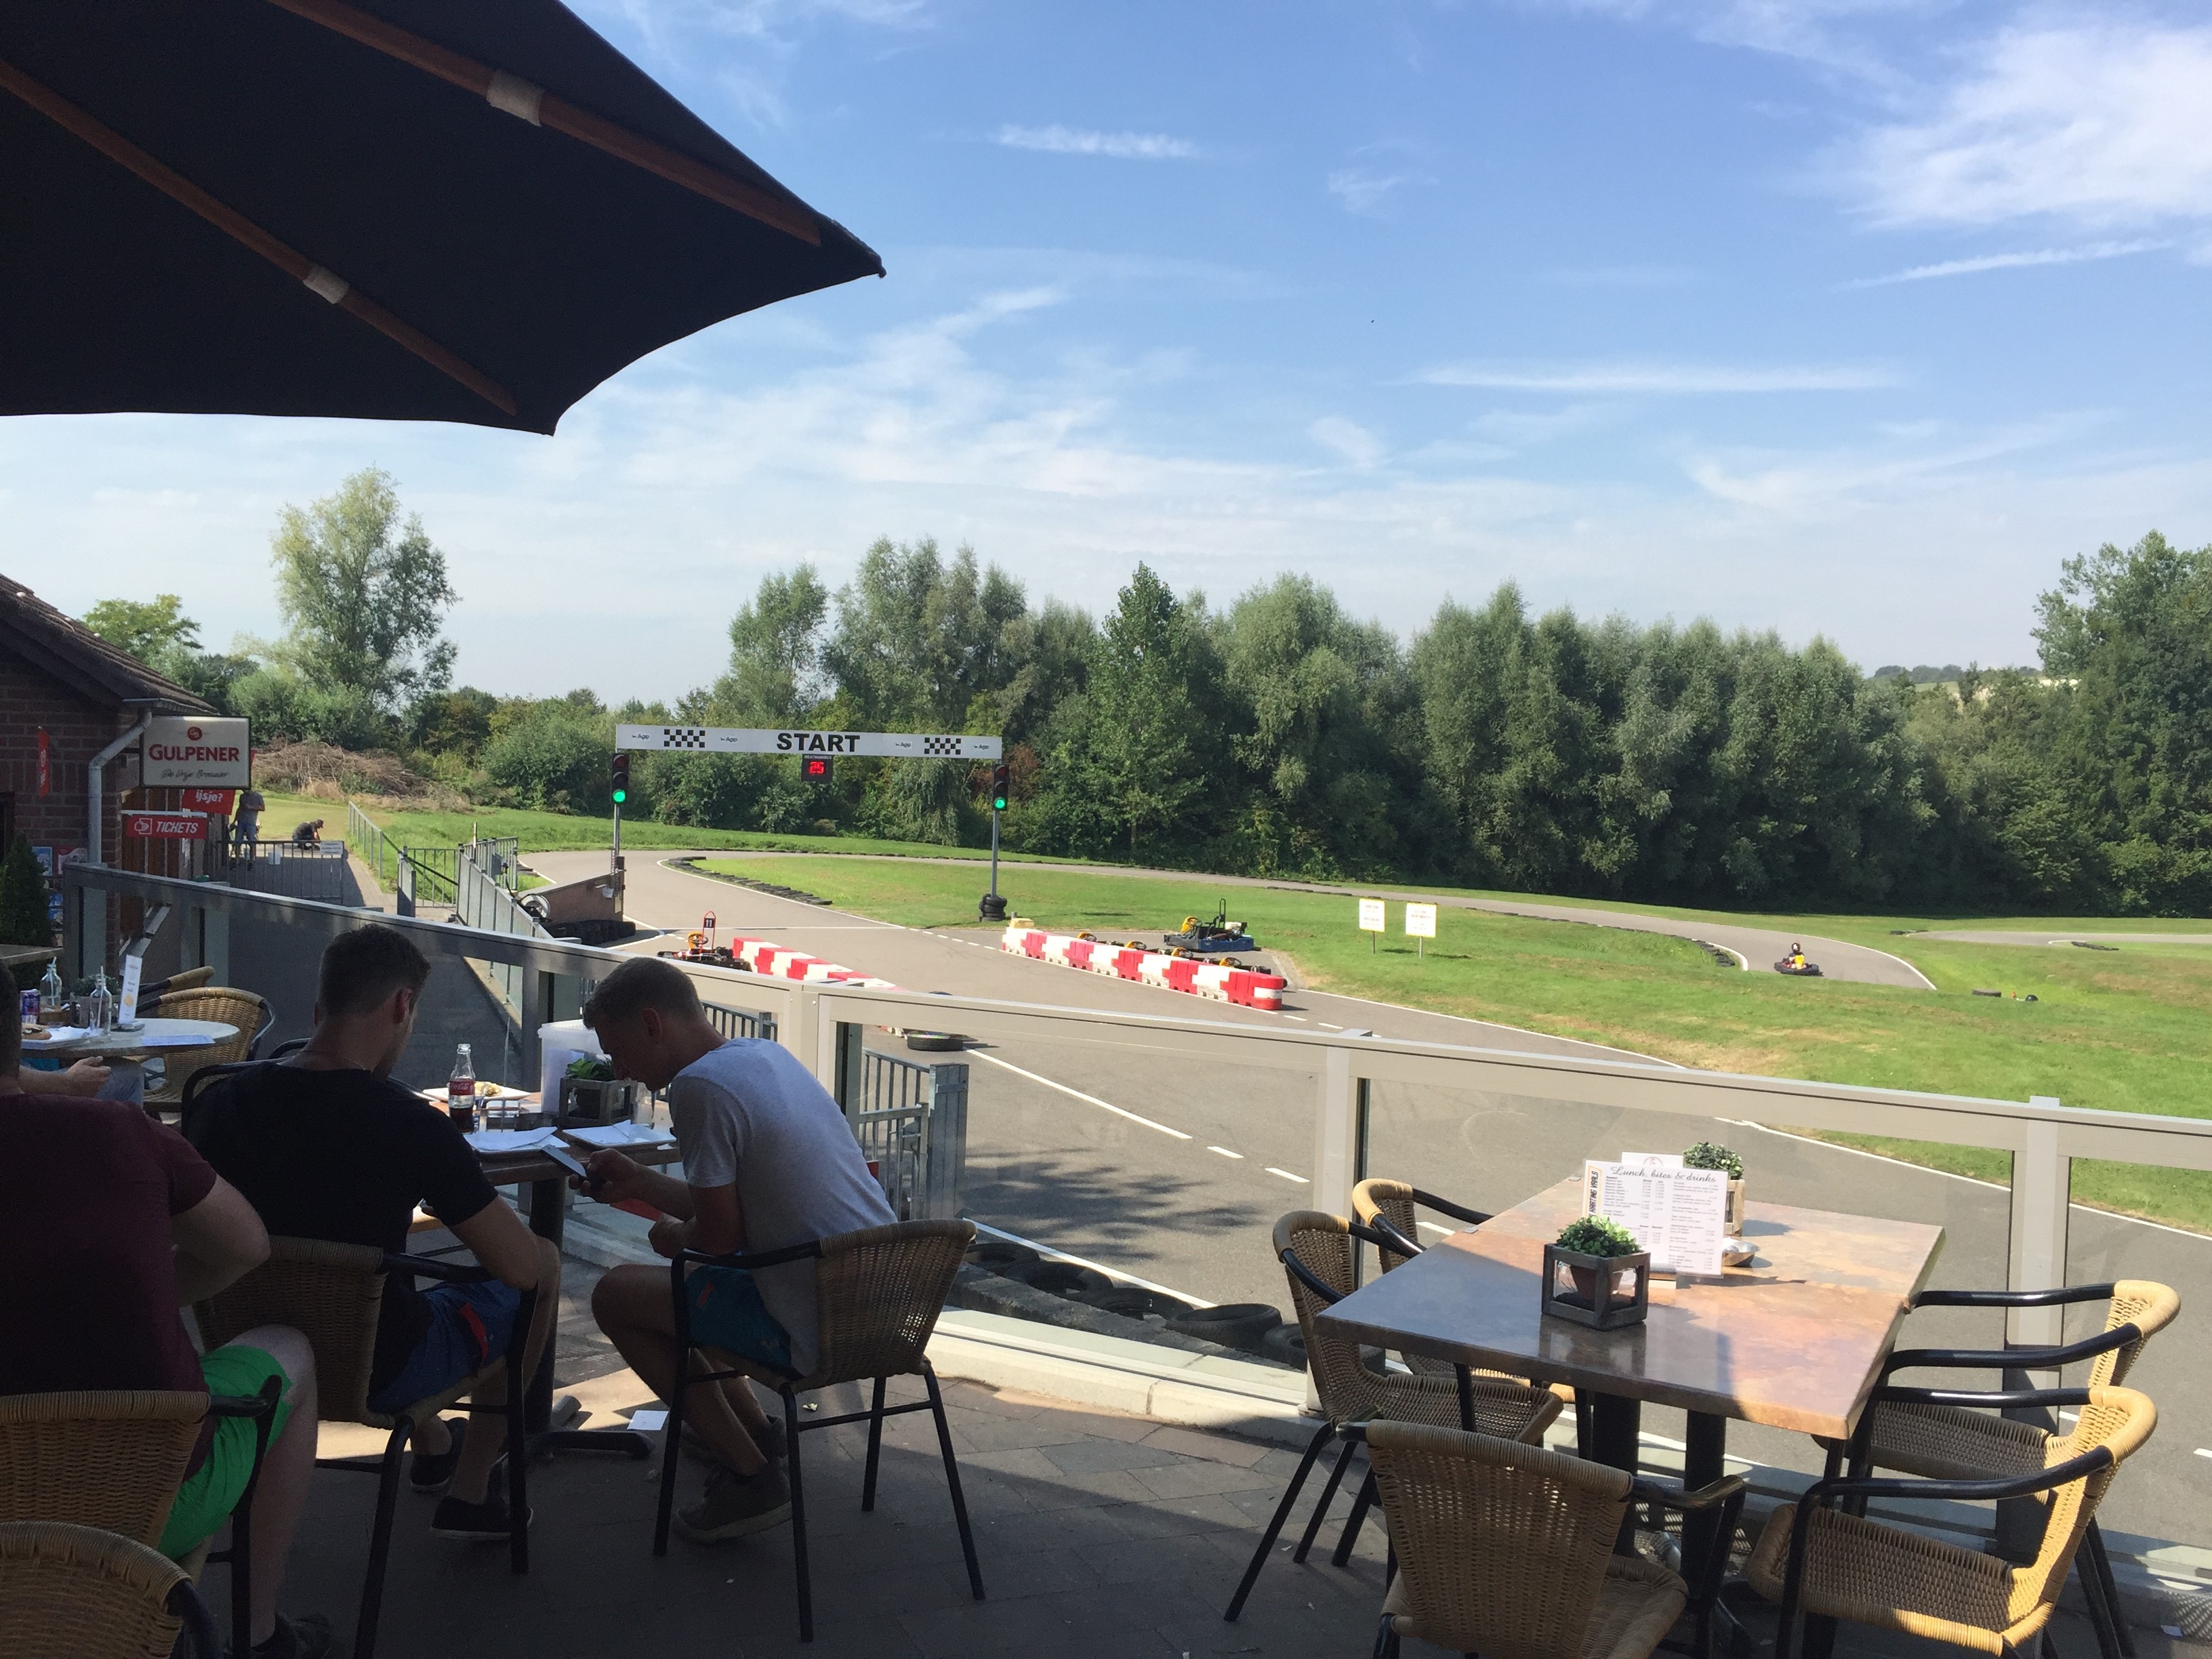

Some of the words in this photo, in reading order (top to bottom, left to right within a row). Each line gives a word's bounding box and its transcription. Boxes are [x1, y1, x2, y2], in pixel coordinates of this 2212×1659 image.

[777, 733, 860, 752] START
[148, 744, 239, 762] GULPENER
[156, 821, 199, 834] TICKETS
[705, 919, 712, 928] 11
[1651, 1169, 1672, 1179] bites
[1687, 1172, 1717, 1183] drinks
